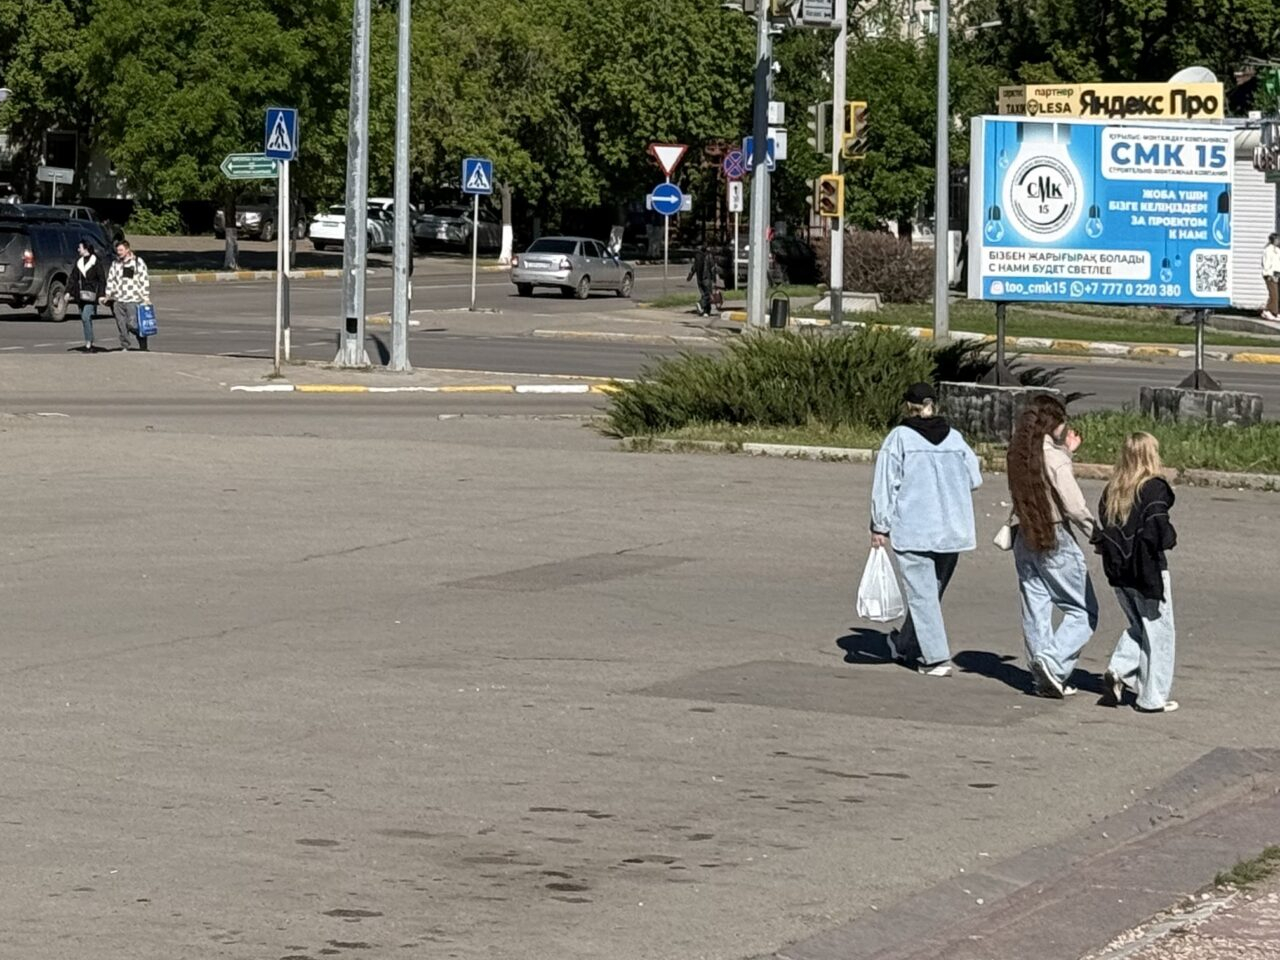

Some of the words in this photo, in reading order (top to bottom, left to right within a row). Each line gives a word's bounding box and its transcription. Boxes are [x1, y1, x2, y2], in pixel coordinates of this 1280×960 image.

[1080, 89, 1164, 119] Яндекс
[1170, 89, 1218, 119] Про
[1111, 141, 1185, 167] СМК
[1195, 144, 1227, 169] 15
[1142, 189, 1177, 200] ЖОБА
[1038, 204, 1050, 215] 15
[1130, 215, 1146, 226] ЗА
[1148, 216, 1208, 228] ПРОЕКТОМ
[988, 250, 1026, 261] БІЗБЕН
[1099, 253, 1145, 265] БОЛАДЫ
[988, 263, 996, 273] С
[998, 263, 1030, 273] НАМИ
[1032, 264, 1065, 275] БУДЕТ
[1067, 265, 1113, 275] СВЕТЛЕЕ
[1084, 282, 1099, 295] +7
[1101, 283, 1123, 296] 777
[1135, 284, 1158, 297] 220
